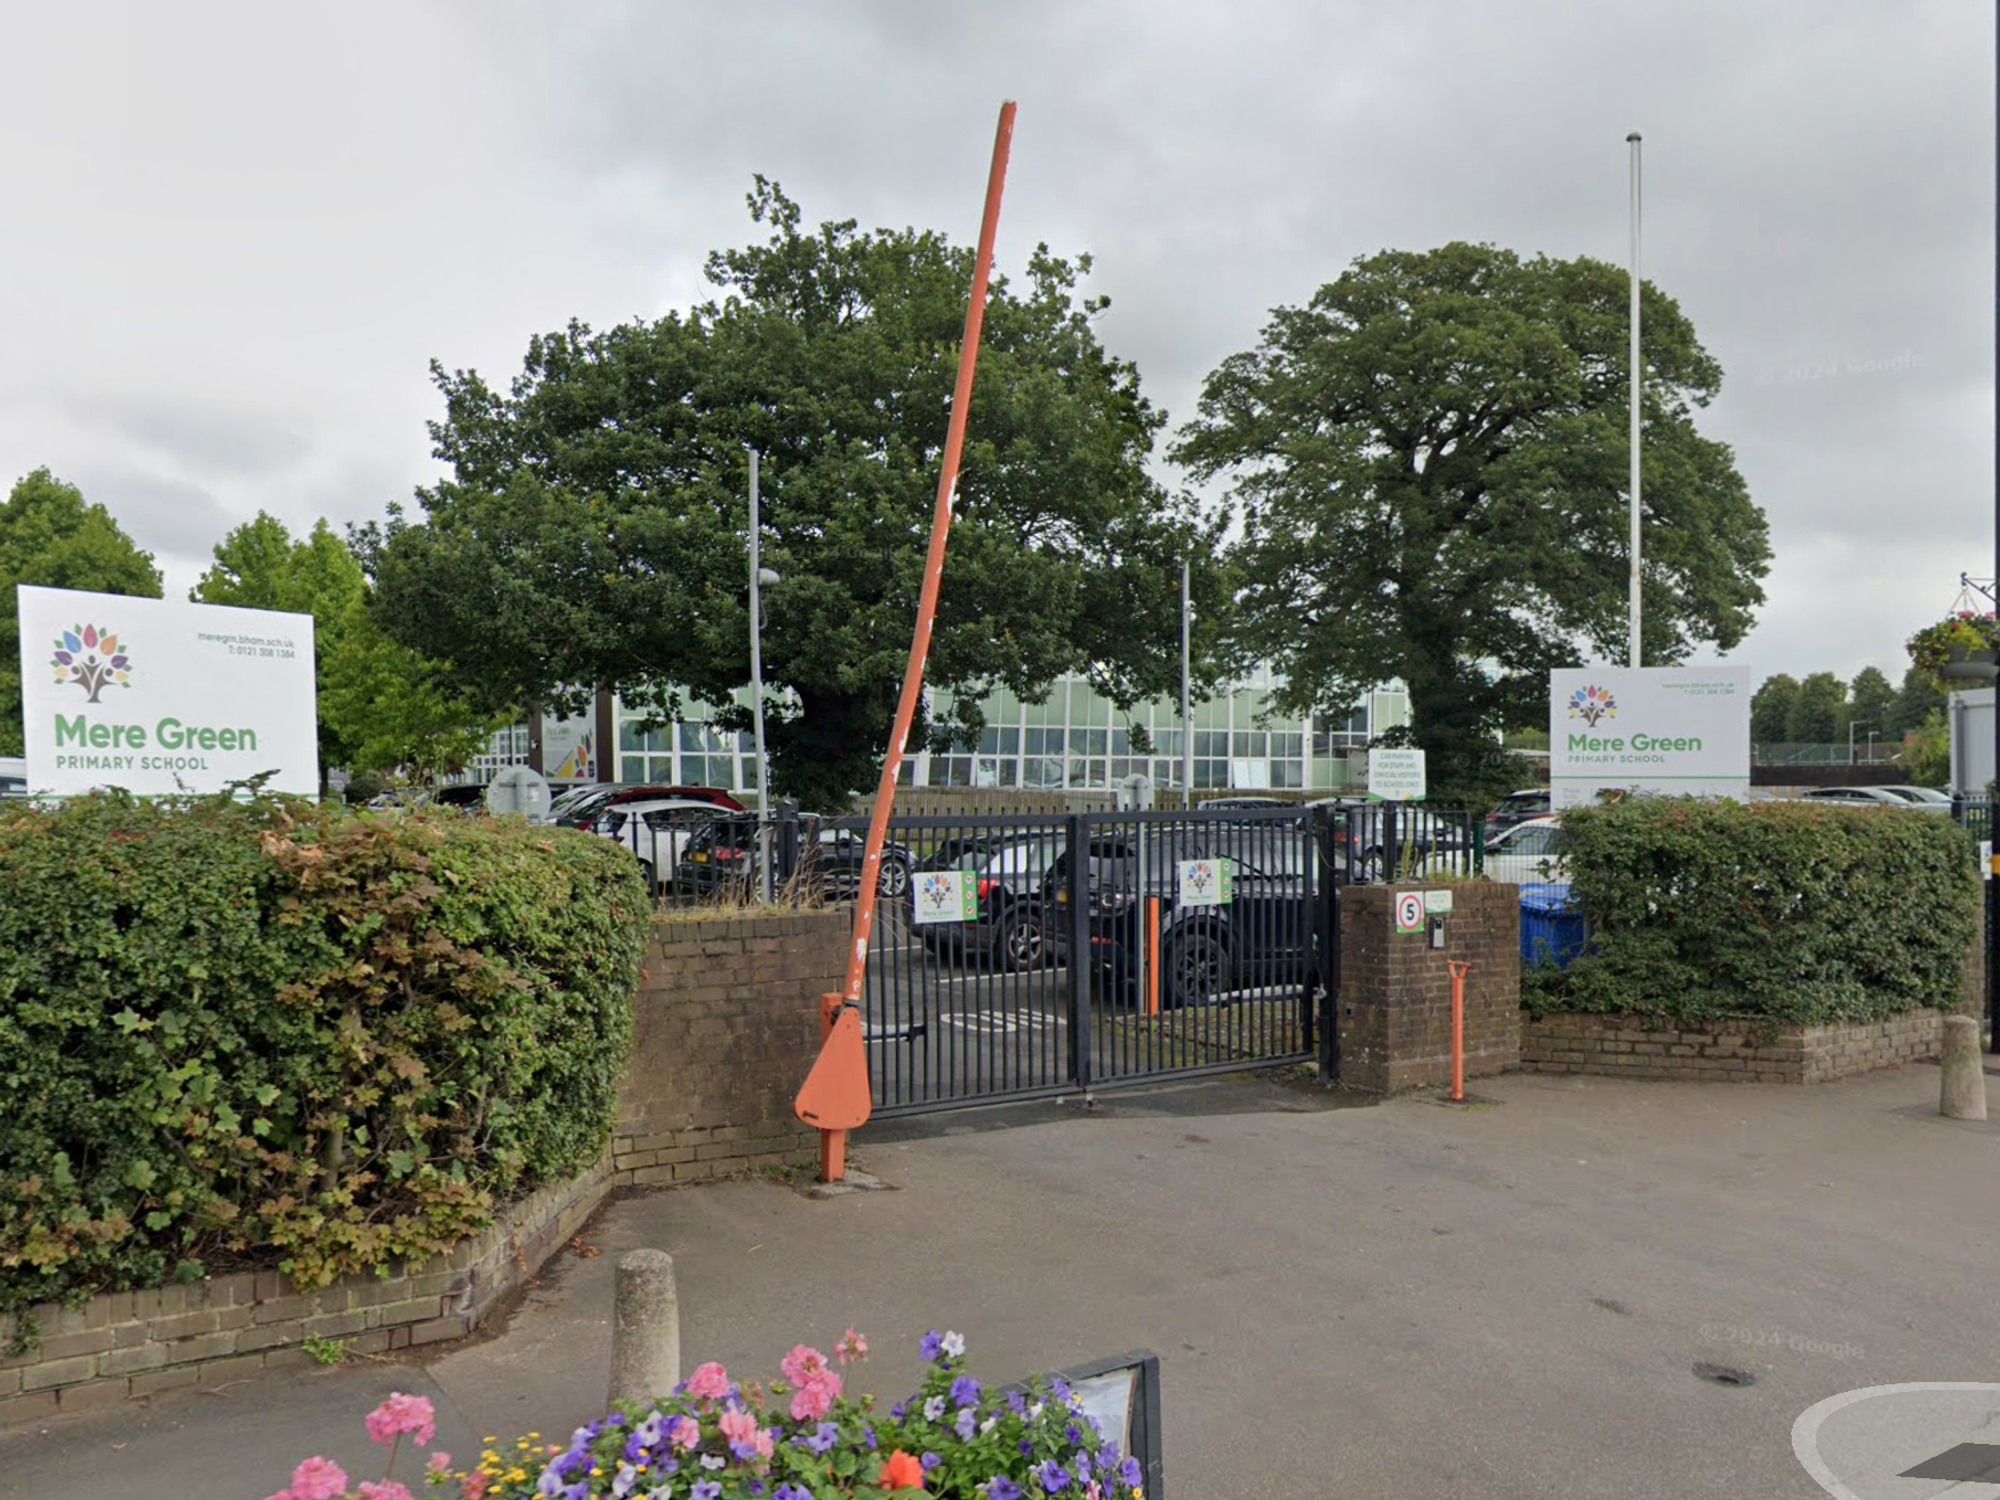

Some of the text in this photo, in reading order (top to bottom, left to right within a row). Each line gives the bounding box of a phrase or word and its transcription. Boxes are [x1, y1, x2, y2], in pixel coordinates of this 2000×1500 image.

[237, 645, 257, 656] 0121
[259, 647, 274, 658] 308
[276, 649, 295, 659] 1384
[54, 713, 257, 751] Mere Green
[1568, 733, 1702, 752] Mere Green
[56, 755, 208, 771] PRIMARY SCHOOL
[1568, 755, 1666, 764] PRIMARY SCHOOL
[1406, 903, 1415, 921] 5
